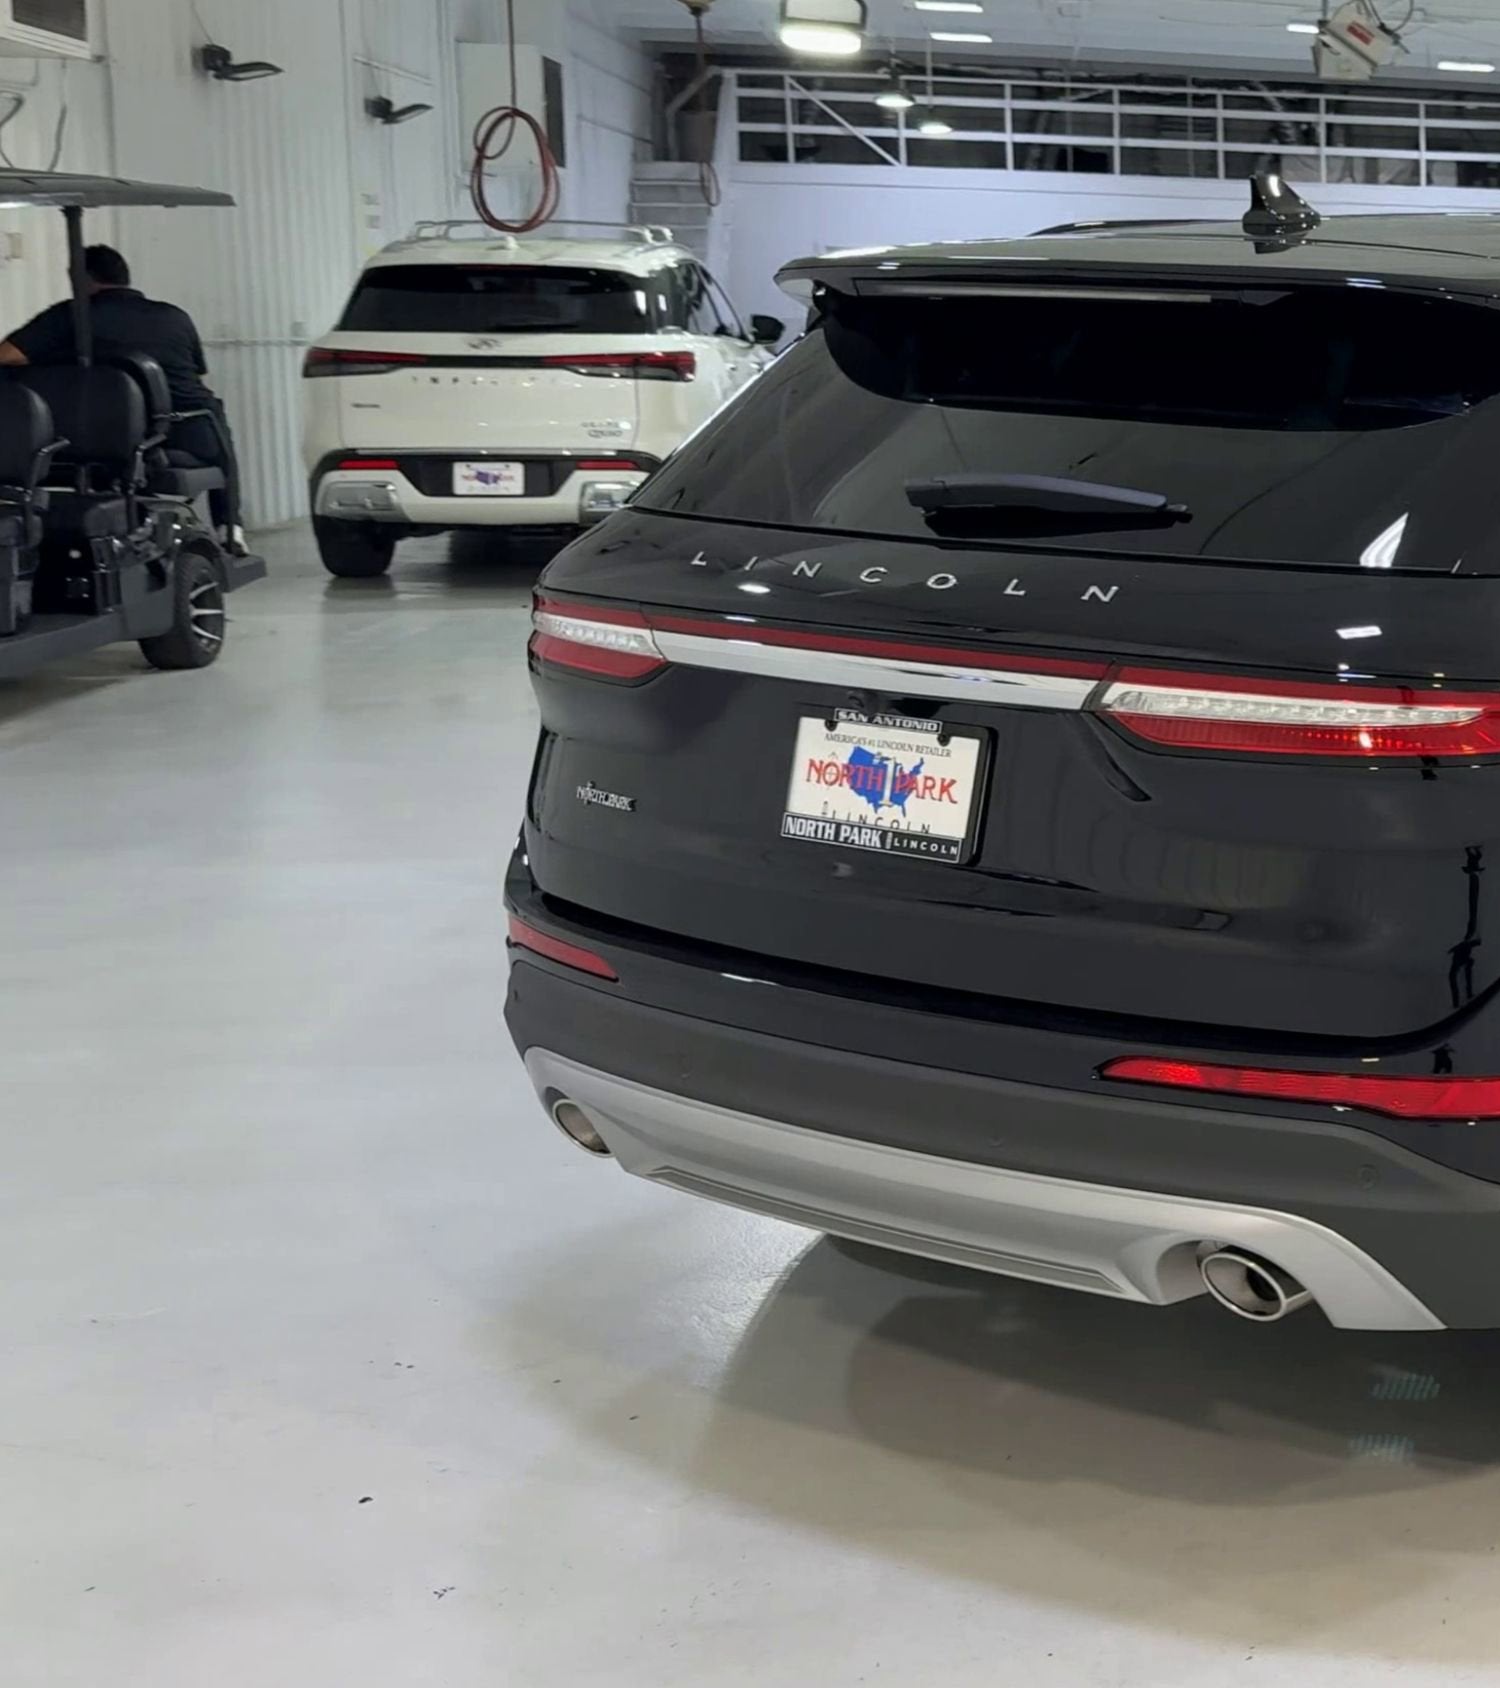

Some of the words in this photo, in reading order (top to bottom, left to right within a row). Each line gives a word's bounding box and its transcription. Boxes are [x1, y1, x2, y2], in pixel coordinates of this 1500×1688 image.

[691, 551, 1119, 602] LINCOLN
[838, 710, 869, 723] SAN
[873, 715, 938, 731] ANTONIO
[877, 740, 914, 752] LINCOLN
[915, 744, 952, 757] RETAILER
[806, 759, 884, 791] NORTH
[895, 767, 958, 804] PARK
[785, 816, 835, 841] NORTH
[840, 824, 882, 848] PARK
[894, 837, 958, 854] LINCOLN
